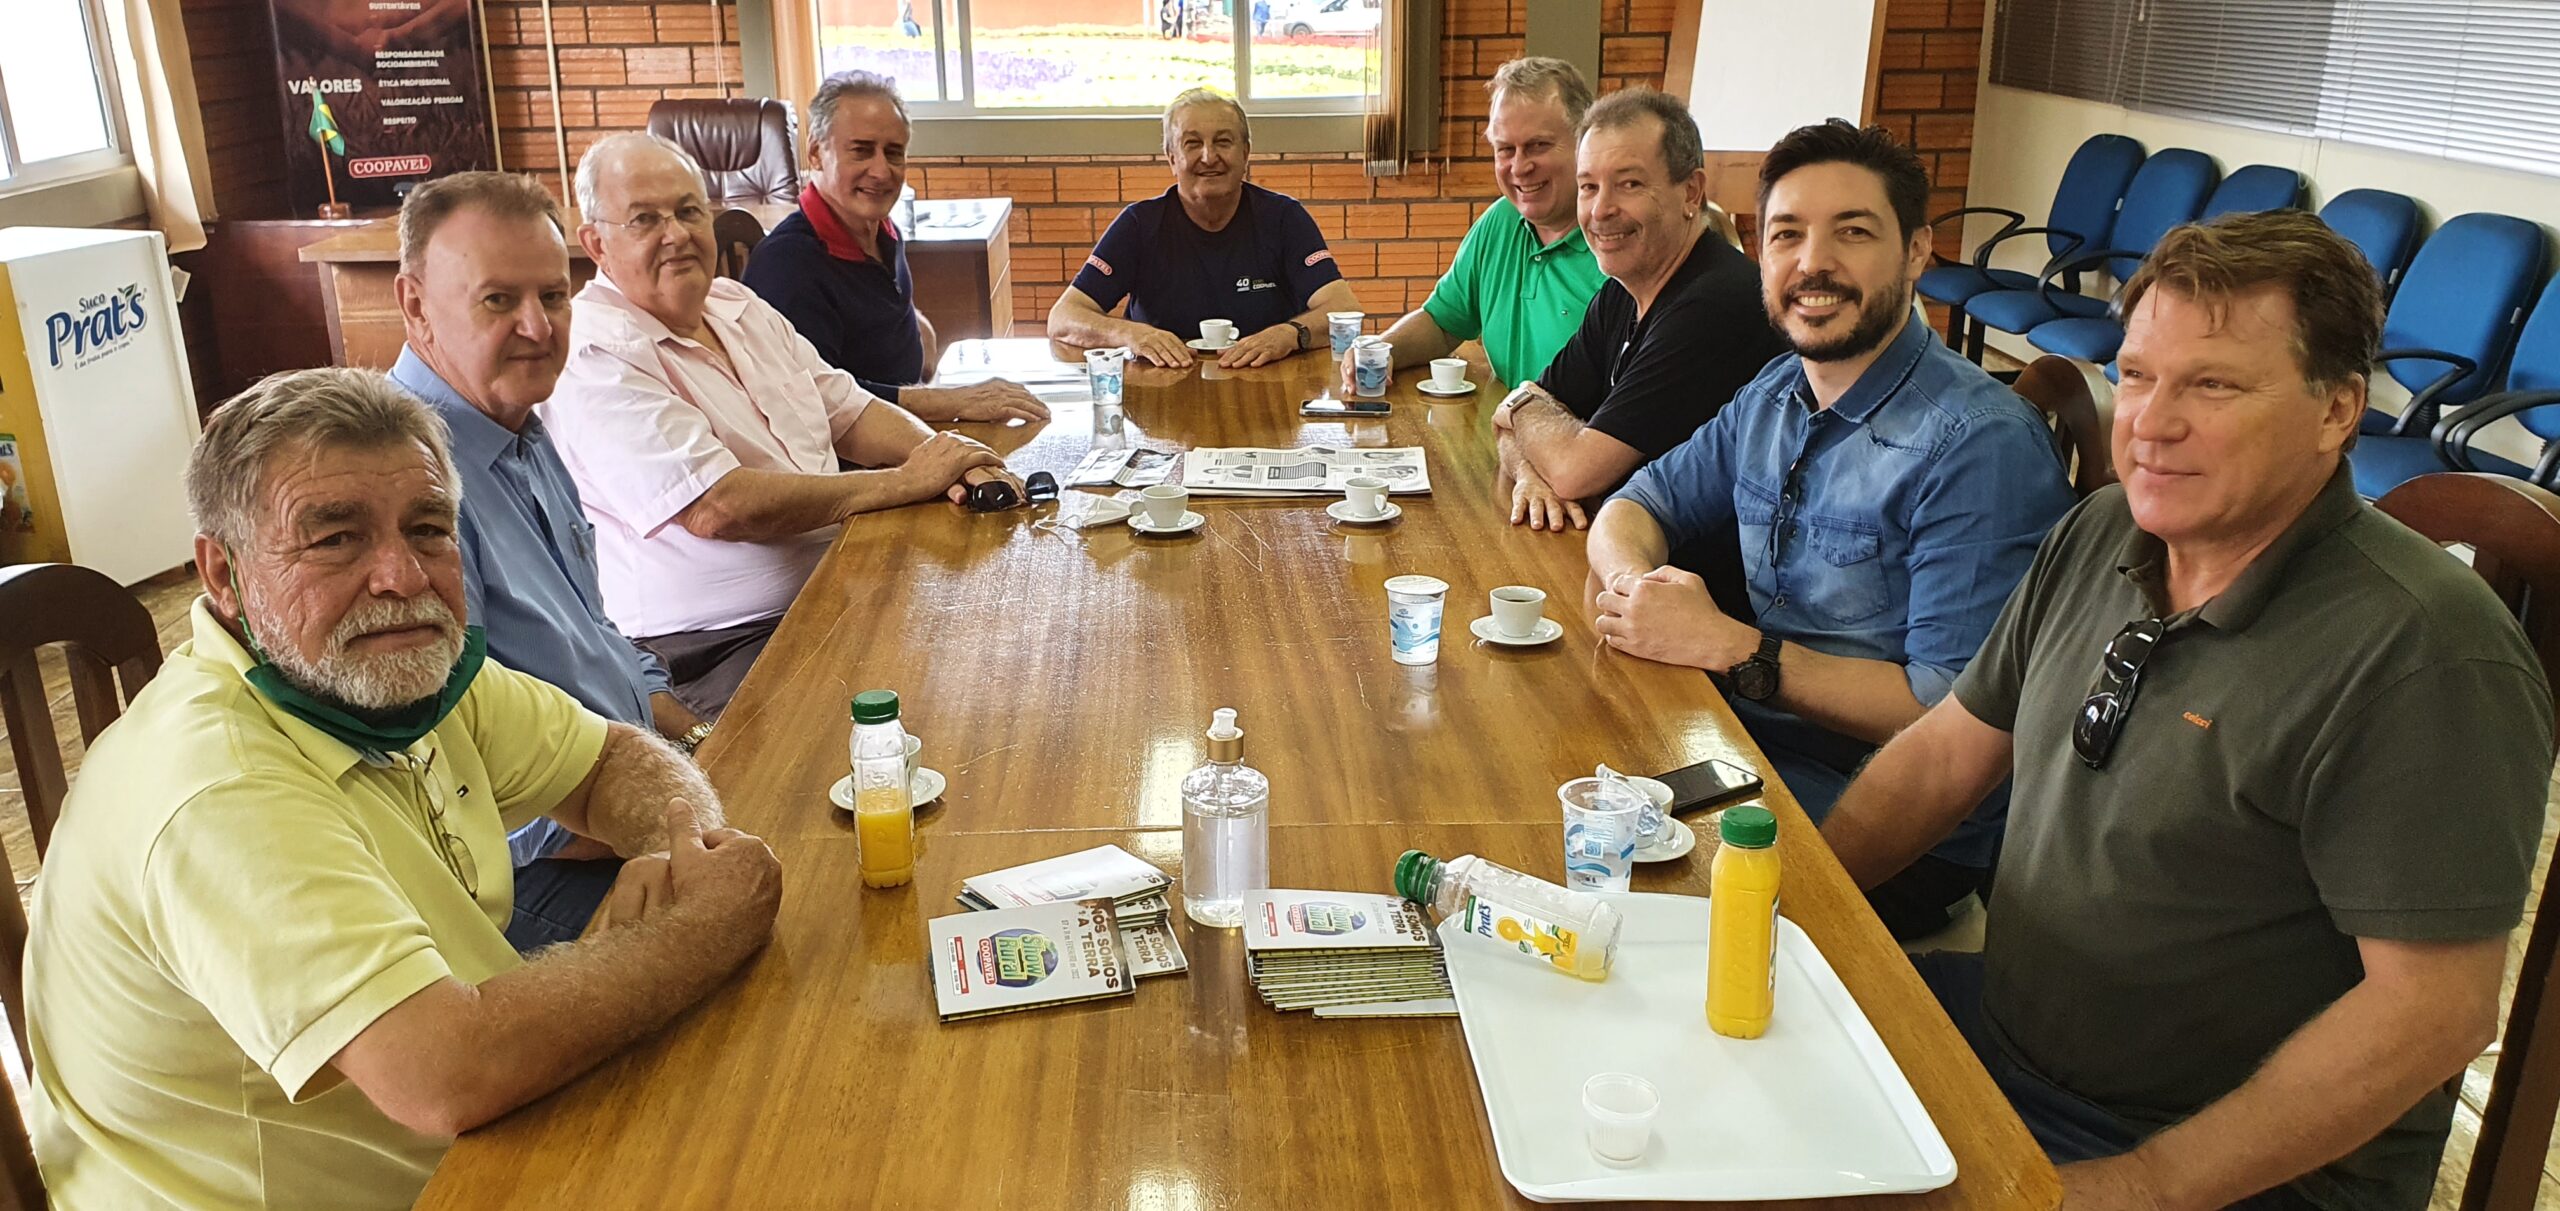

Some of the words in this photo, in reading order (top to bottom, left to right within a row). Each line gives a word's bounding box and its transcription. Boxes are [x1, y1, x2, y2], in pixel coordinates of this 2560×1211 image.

[375, 50, 445, 59] RESPONSABILIDADE
[376, 59, 439, 68] SOCIOAMBIENTAL
[287, 79, 362, 95] VAORES
[400, 78, 451, 87] PROFISSIONAL
[381, 96, 432, 106] VALORIZAÇÃO
[433, 95, 464, 104] PESSOAS
[383, 116, 417, 125] RESPEITO
[353, 158, 429, 175] COOPAVEL
[1236, 278, 1250, 287] 40
[79, 293, 106, 313] Suco
[1389, 910, 1408, 935] TERRA
[1404, 914, 1426, 942] SOMOS
[980, 939, 996, 984] COOPAVEL
[998, 937, 1024, 979] Rural
[1020, 935, 1044, 977] Show
[1080, 931, 1101, 978] TERRA
[1097, 938, 1119, 989] SOMOS
